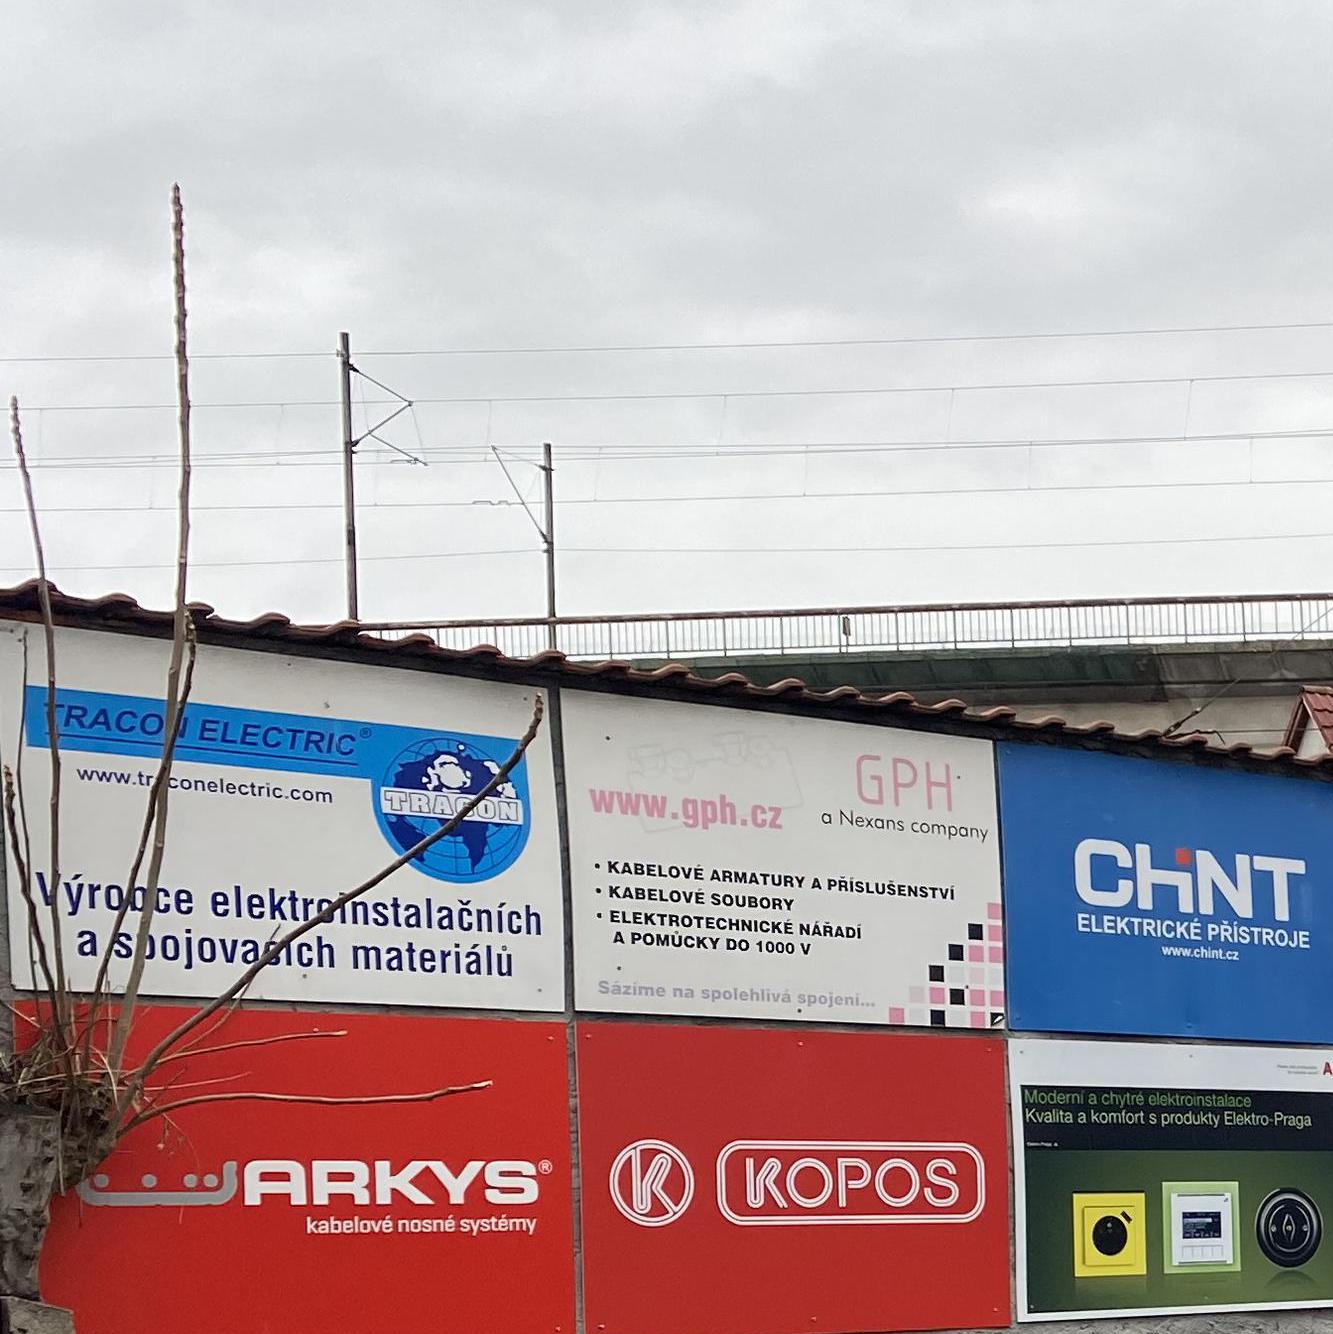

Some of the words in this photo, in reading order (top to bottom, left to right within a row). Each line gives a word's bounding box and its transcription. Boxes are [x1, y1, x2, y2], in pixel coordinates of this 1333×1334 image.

[198, 718, 356, 756] ELECTRIC
[77, 768, 333, 803] www.trconelectric.com
[856, 754, 953, 811] GPH
[384, 789, 519, 822] TRACON
[589, 788, 783, 831] www.gph.cz
[821, 812, 833, 825] a
[840, 809, 905, 833] Nexans
[910, 820, 989, 843] company
[607, 860, 704, 881] KABELOVÉ
[710, 869, 805, 888] ARMATURY
[811, 877, 822, 890] A
[828, 875, 955, 900] PŘÍSLUŠENSTVÍ
[211, 885, 542, 936] elektroinstalačních
[608, 885, 705, 905] KABELOVÉ
[710, 892, 794, 911] SOUBORY
[610, 910, 794, 935] ELEKTROTECHNICKÉ
[799, 919, 862, 940] NÁŘADÍ
[1077, 913, 1202, 941] ELEKTRICKÉ
[1207, 919, 1310, 949] PŘÍSTROJE
[77, 929, 98, 957] a
[351, 941, 513, 977] materiálů
[613, 932, 625, 945] A
[631, 930, 720, 950] POMŮCKY
[726, 937, 749, 951] DO
[756, 940, 795, 955] 1000
[800, 942, 811, 955] V
[1161, 945, 1240, 961] www.chint.cz
[598, 980, 666, 998] Sázíme
[672, 986, 695, 1000] na
[701, 986, 791, 1005] spolehlivá
[1024, 1088, 1084, 1105] Moderní
[1088, 1093, 1098, 1105] a
[1101, 1090, 1145, 1108] chytré
[1148, 1092, 1252, 1108] elektroinstalace
[1025, 1108, 1073, 1124] Kvalita
[1077, 1113, 1087, 1124] a
[1091, 1109, 1145, 1125] komfort
[1149, 1114, 1158, 1125] s
[1161, 1111, 1220, 1128] produkty
[1223, 1111, 1312, 1130] Elektro-Praga
[244, 1159, 539, 1206] ARKYS
[745, 1157, 960, 1208] KOPOS
[306, 1214, 393, 1235] kabelové
[398, 1214, 455, 1234] nosné
[460, 1214, 536, 1236] systémy
